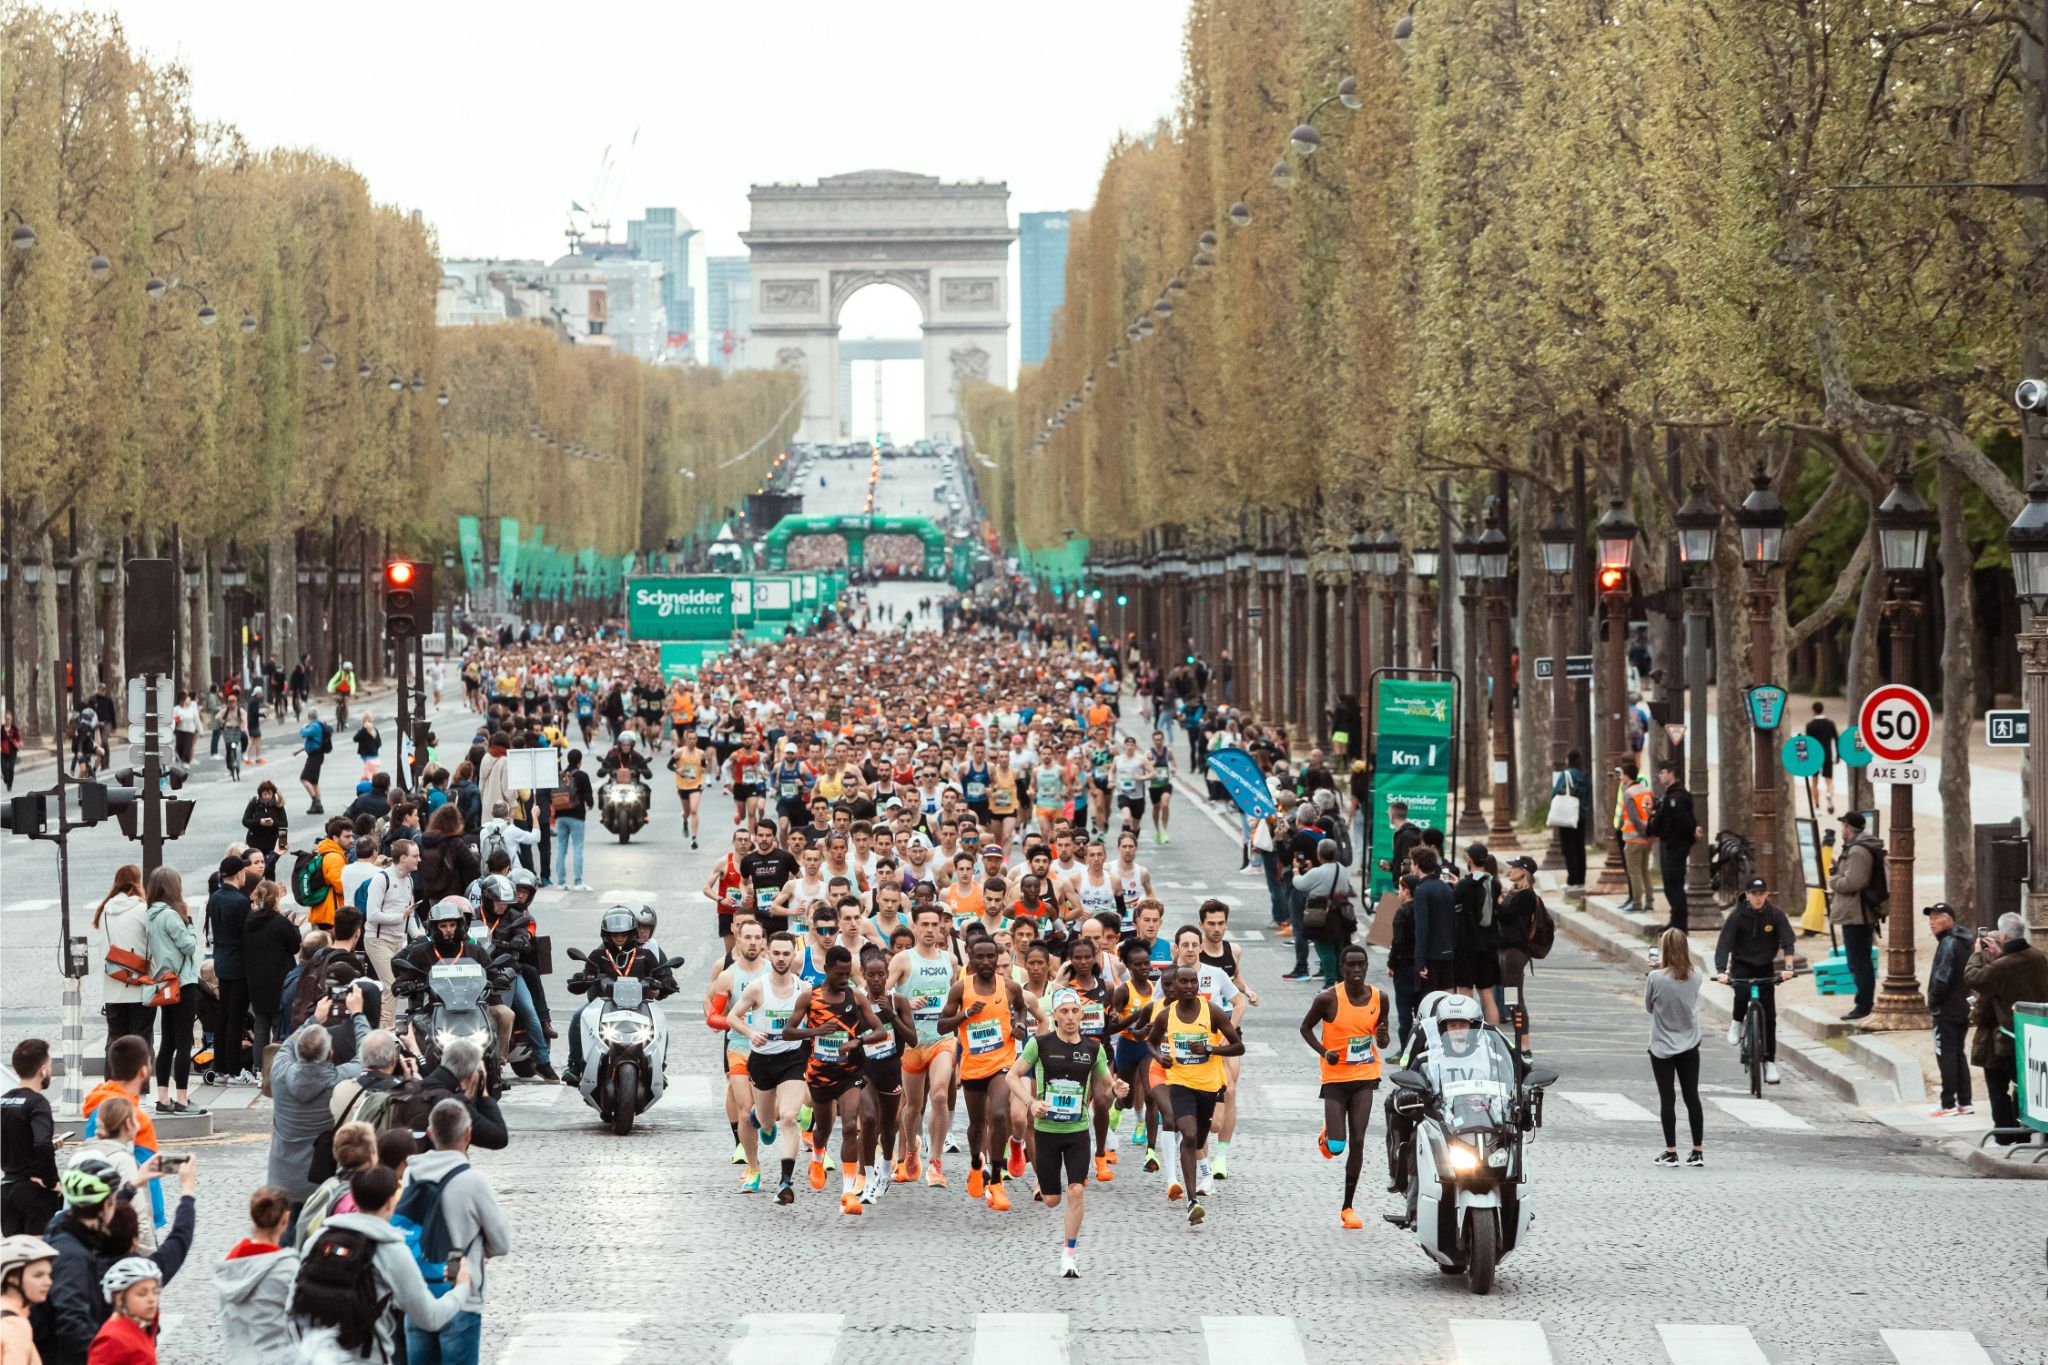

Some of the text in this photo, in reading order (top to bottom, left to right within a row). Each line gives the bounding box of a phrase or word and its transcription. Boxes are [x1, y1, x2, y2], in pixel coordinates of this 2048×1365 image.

[637, 588, 725, 606] Schneider
[674, 604, 723, 615] Electric
[1876, 710, 1917, 741] 50
[1391, 744, 1437, 767] Km 1
[1873, 767, 1920, 779] AXE 50
[1386, 793, 1438, 806] Schneider
[920, 966, 948, 976] HOKA
[1446, 1067, 1474, 1082] TV
[1058, 1095, 1072, 1107] 114
